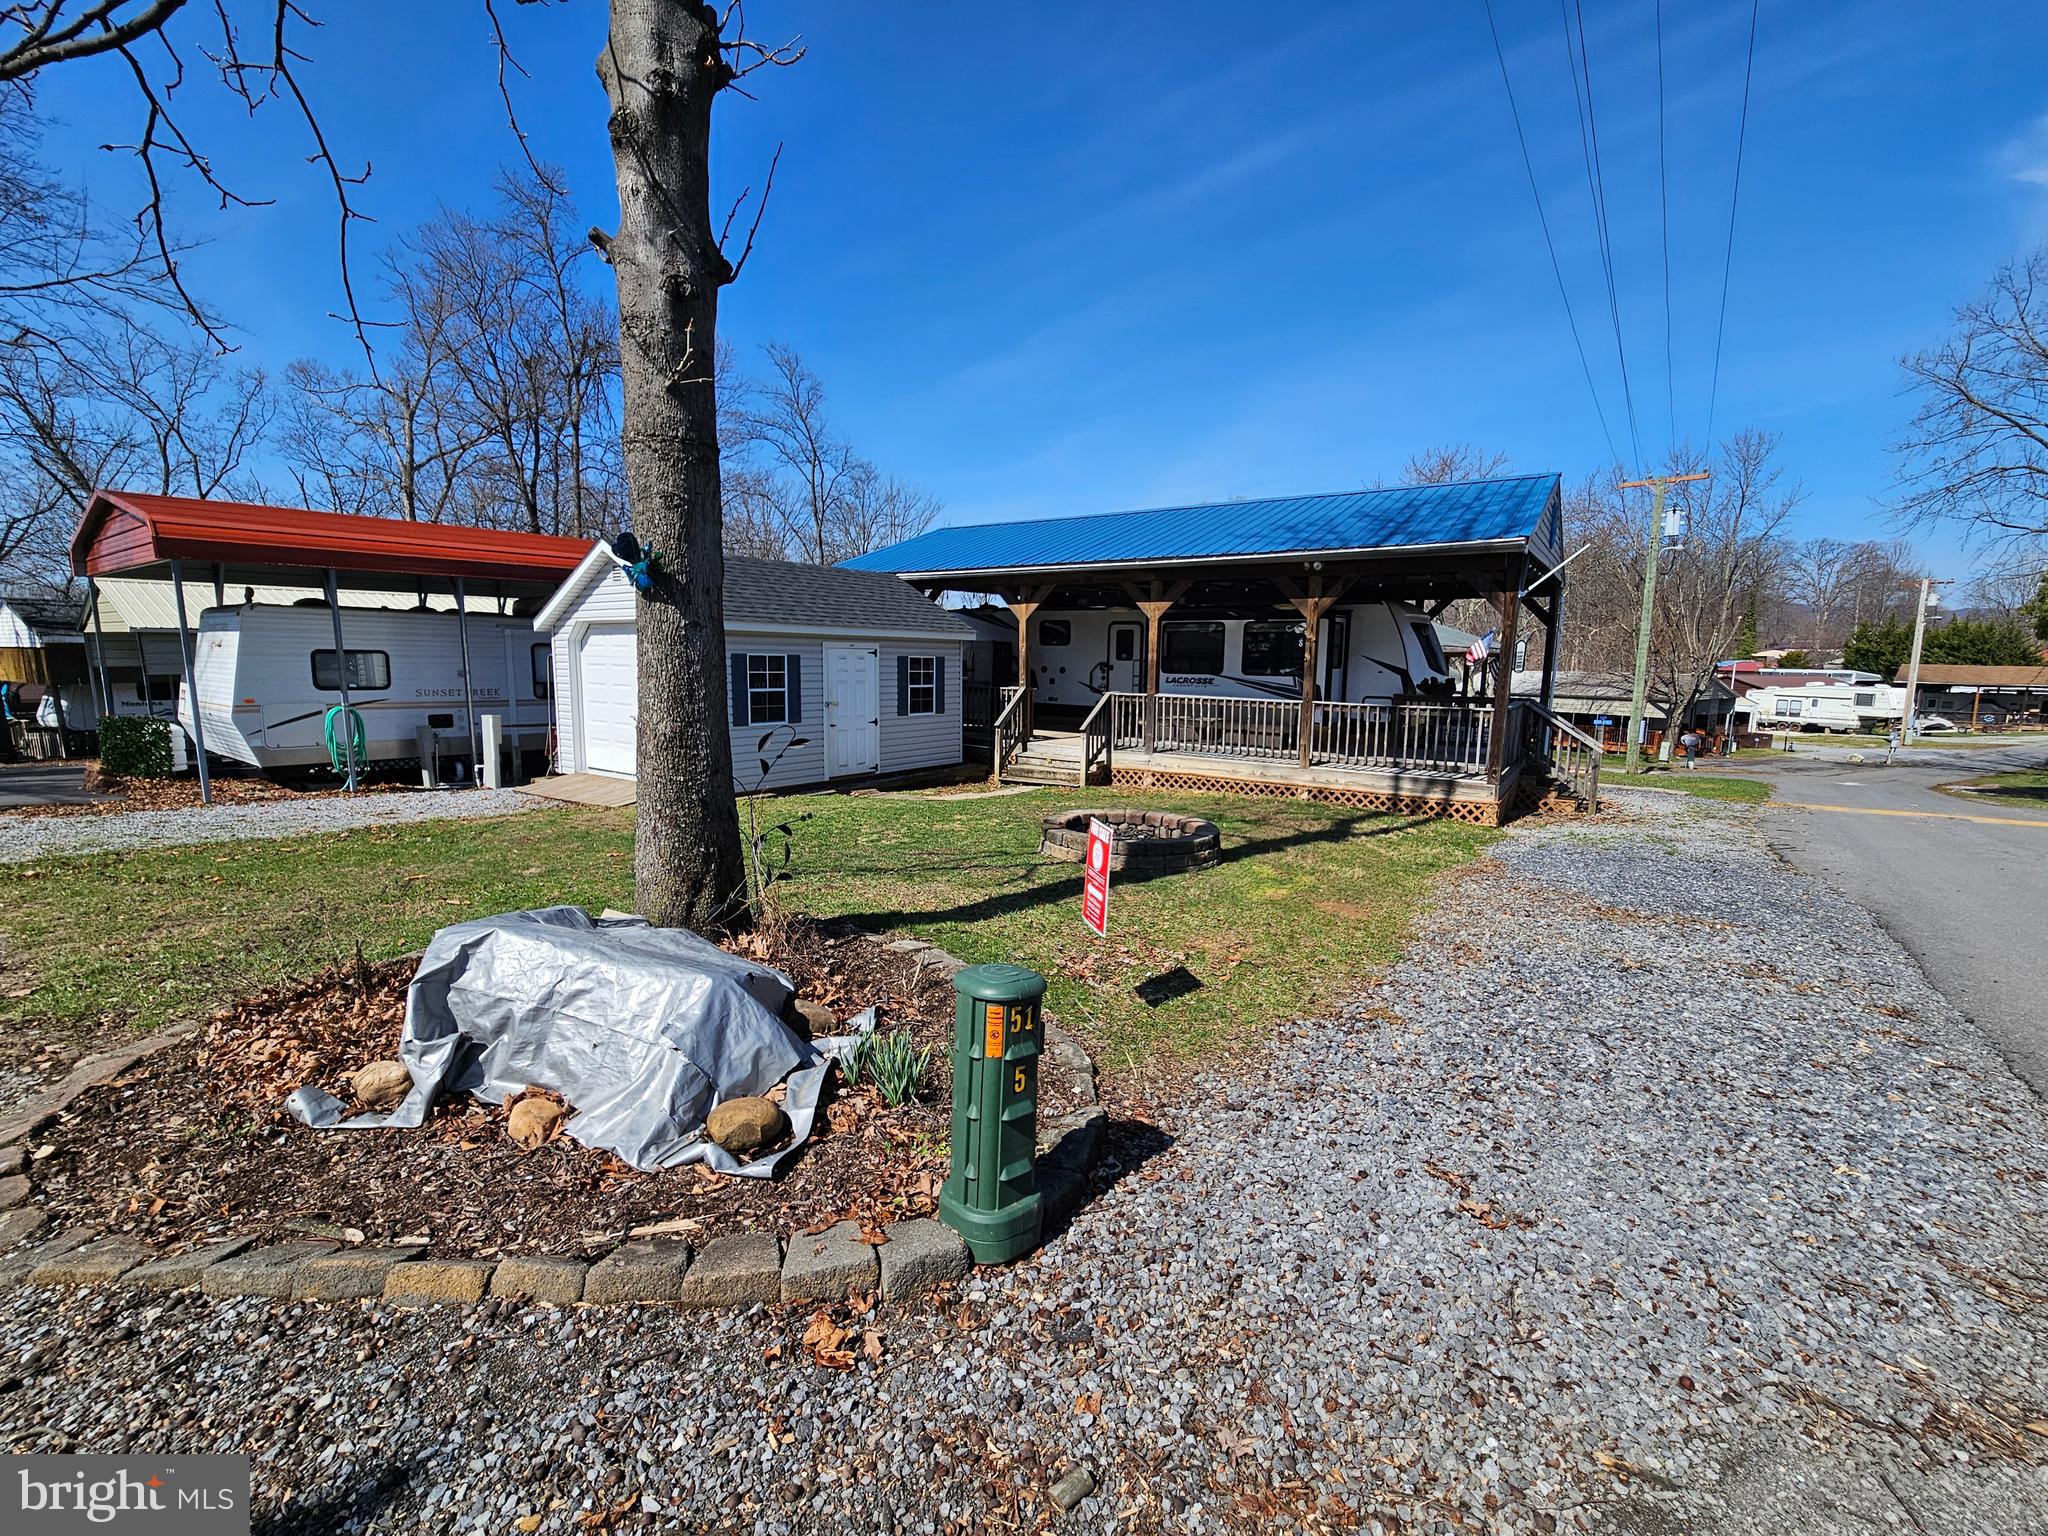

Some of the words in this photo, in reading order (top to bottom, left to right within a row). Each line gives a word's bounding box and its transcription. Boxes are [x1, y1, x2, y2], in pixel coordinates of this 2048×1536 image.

[1165, 676, 1215, 685] LACROSSE
[415, 688, 462, 697] SUNSET
[465, 688, 501, 697] REEK
[1010, 1005, 1033, 1033] 51
[1014, 1064, 1027, 1093] 5
